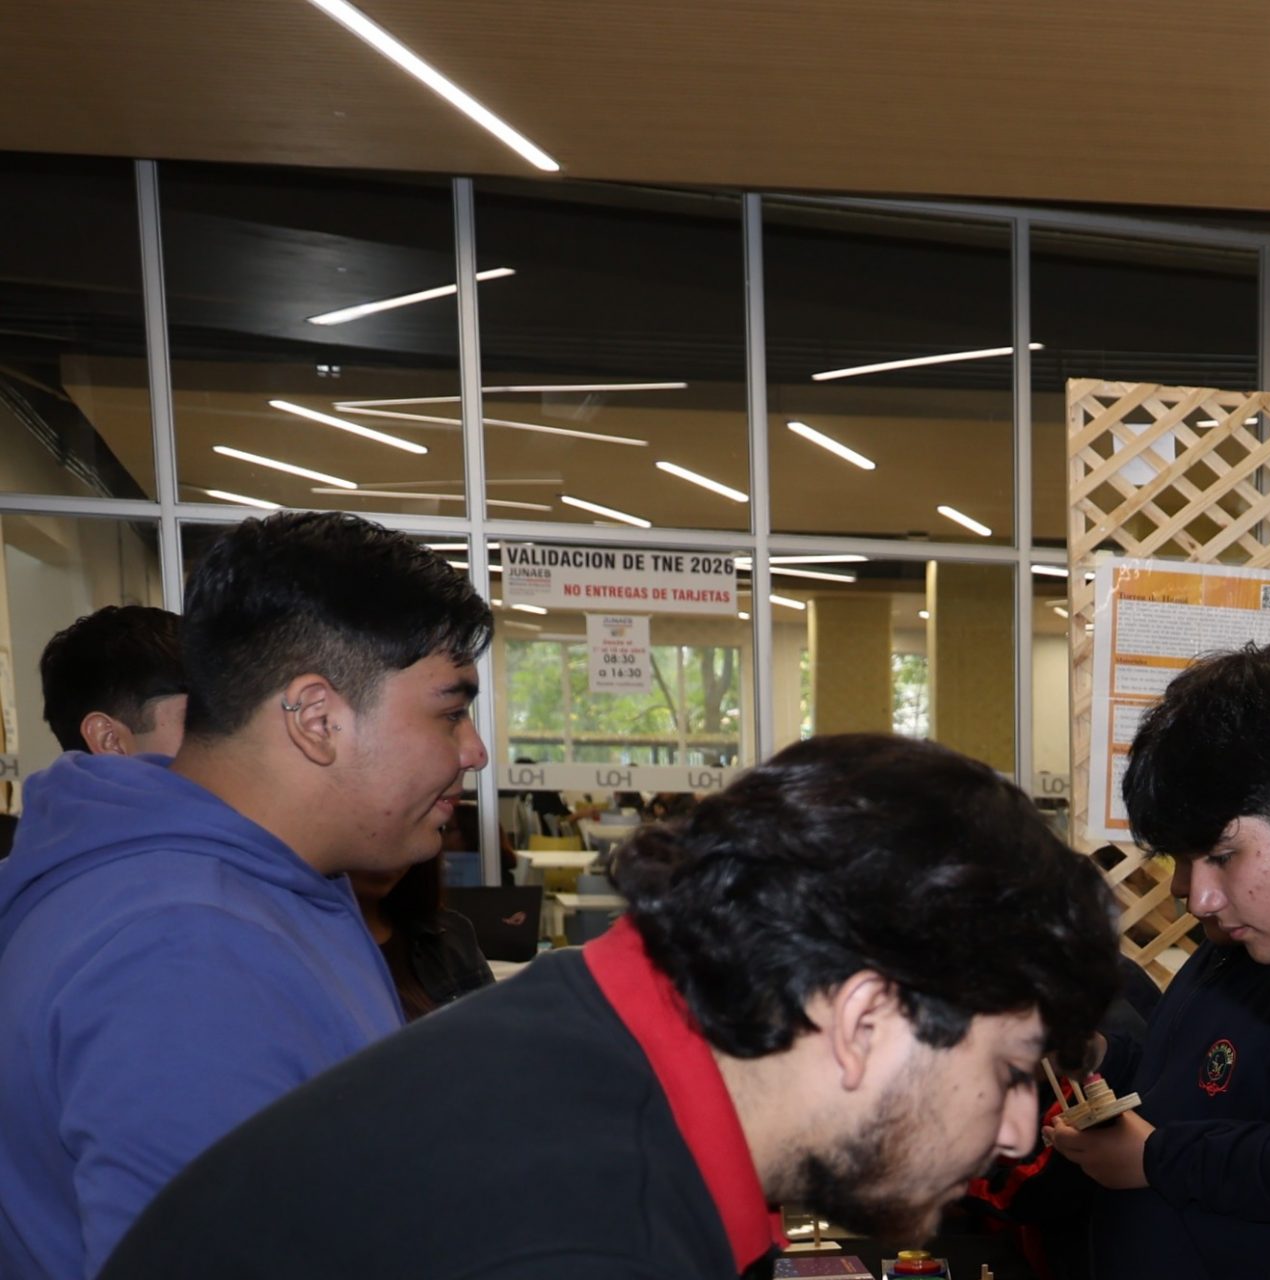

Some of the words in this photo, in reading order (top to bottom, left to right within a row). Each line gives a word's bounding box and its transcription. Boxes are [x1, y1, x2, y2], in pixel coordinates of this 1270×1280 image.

[507, 548, 615, 569] VALIDACION
[623, 553, 645, 571] DE
[652, 555, 684, 573] TNE
[690, 557, 734, 575] 2026
[509, 568, 551, 578] JUNAEB
[564, 584, 581, 596] NO
[585, 585, 648, 599] ENTREGAS
[652, 588, 668, 600] DE
[672, 589, 731, 603] TARJETAS
